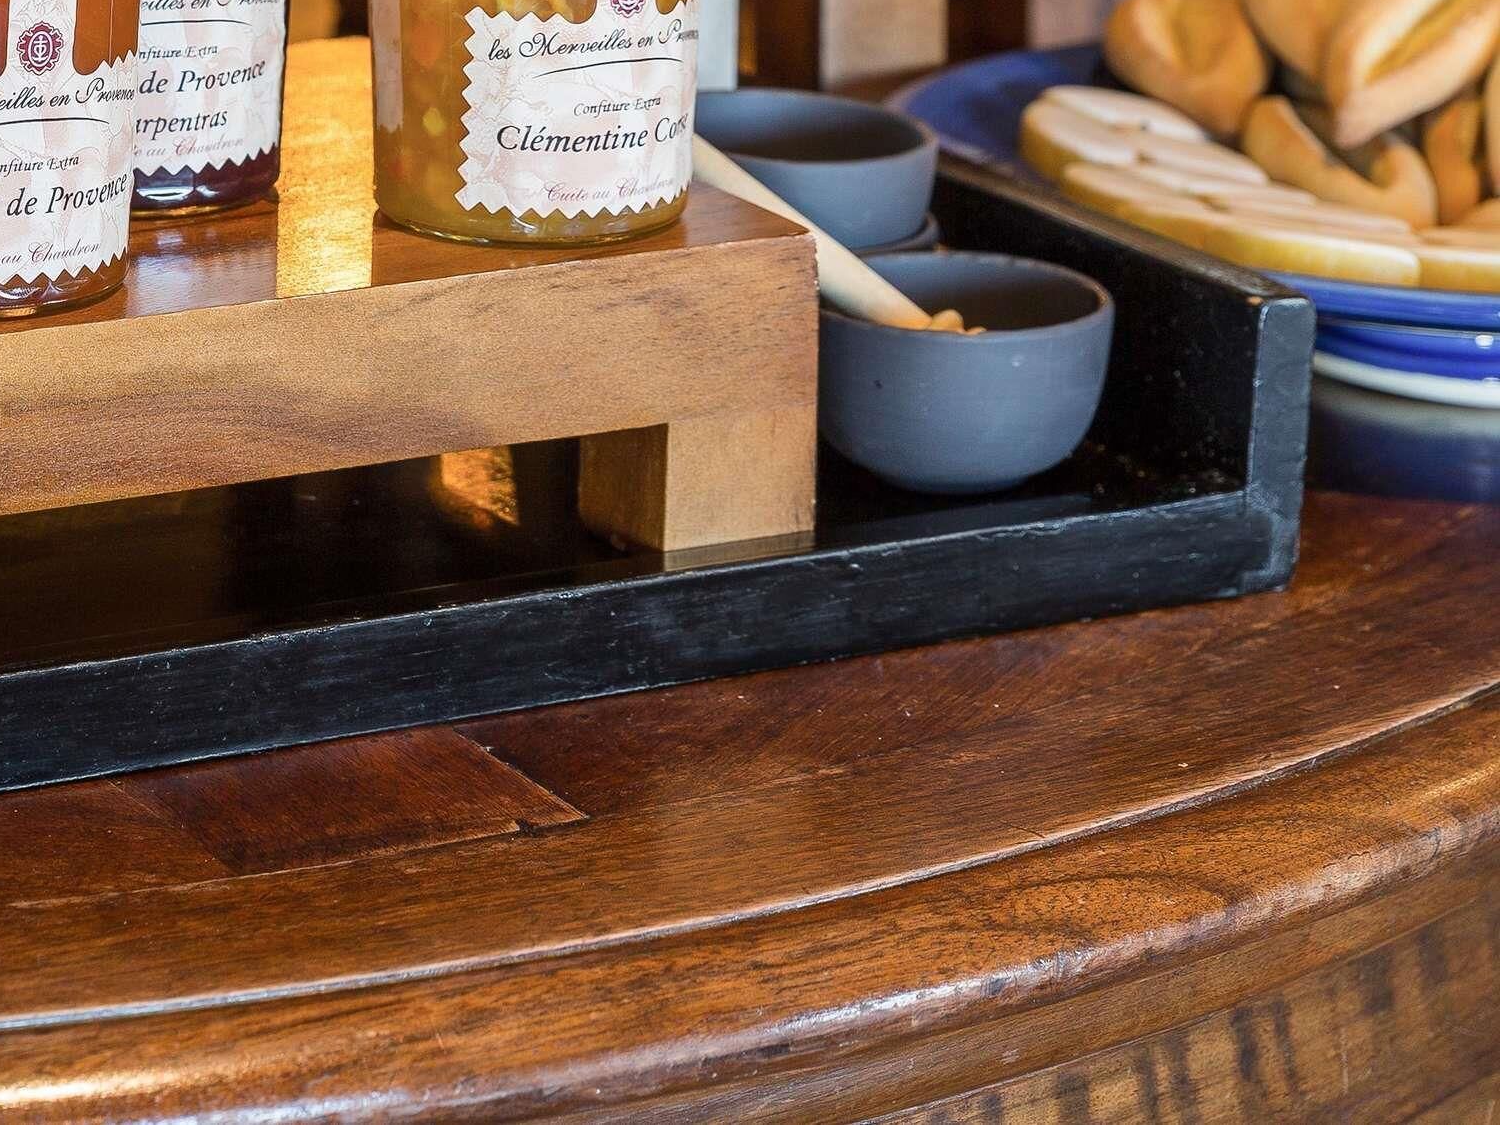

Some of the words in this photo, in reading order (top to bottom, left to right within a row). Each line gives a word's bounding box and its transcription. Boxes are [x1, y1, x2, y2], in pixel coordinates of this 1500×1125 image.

[186, 45, 218, 59] Extra
[488, 38, 511, 61] les
[518, 28, 633, 59] Merveilles
[637, 35, 654, 49] en
[139, 70, 169, 94] de
[177, 60, 266, 93] Provence
[49, 90, 71, 107] en
[75, 77, 136, 103] Provence
[573, 101, 631, 118] Confiture
[634, 96, 661, 112] Extra
[496, 124, 649, 153] Clémentine
[46, 153, 80, 171] Extra
[6, 186, 38, 217] de
[47, 172, 128, 215] Provence
[1, 252, 23, 264] au
[27, 238, 101, 262] Chaudron
